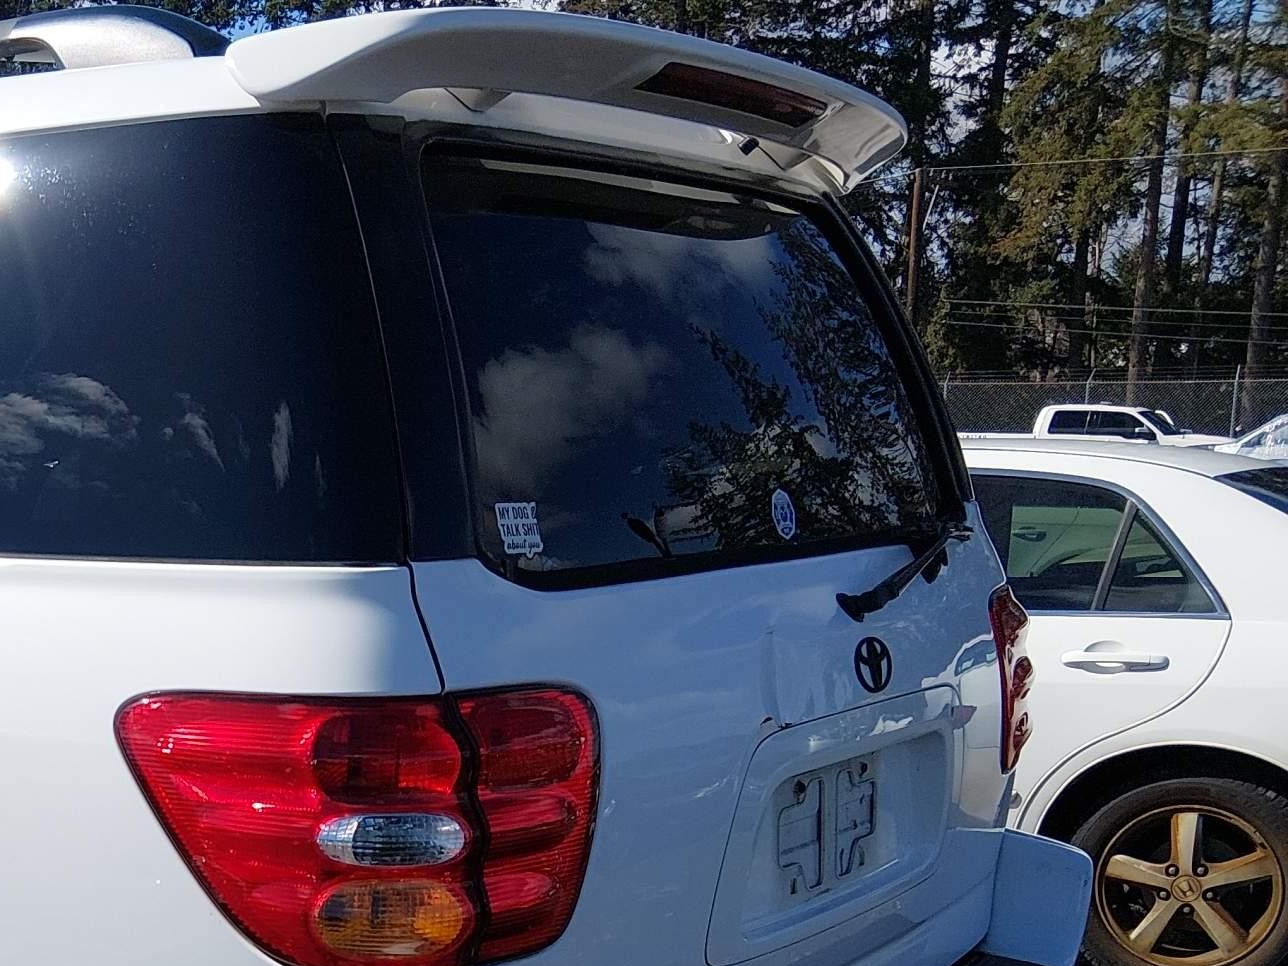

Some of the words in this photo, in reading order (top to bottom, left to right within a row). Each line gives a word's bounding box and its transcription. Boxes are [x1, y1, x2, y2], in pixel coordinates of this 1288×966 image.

[498, 506, 510, 520] MY
[512, 506, 529, 520] DOG
[501, 522, 522, 537] TALK
[522, 522, 539, 537] SHIT
[507, 538, 526, 550] about
[527, 542, 540, 554] you
